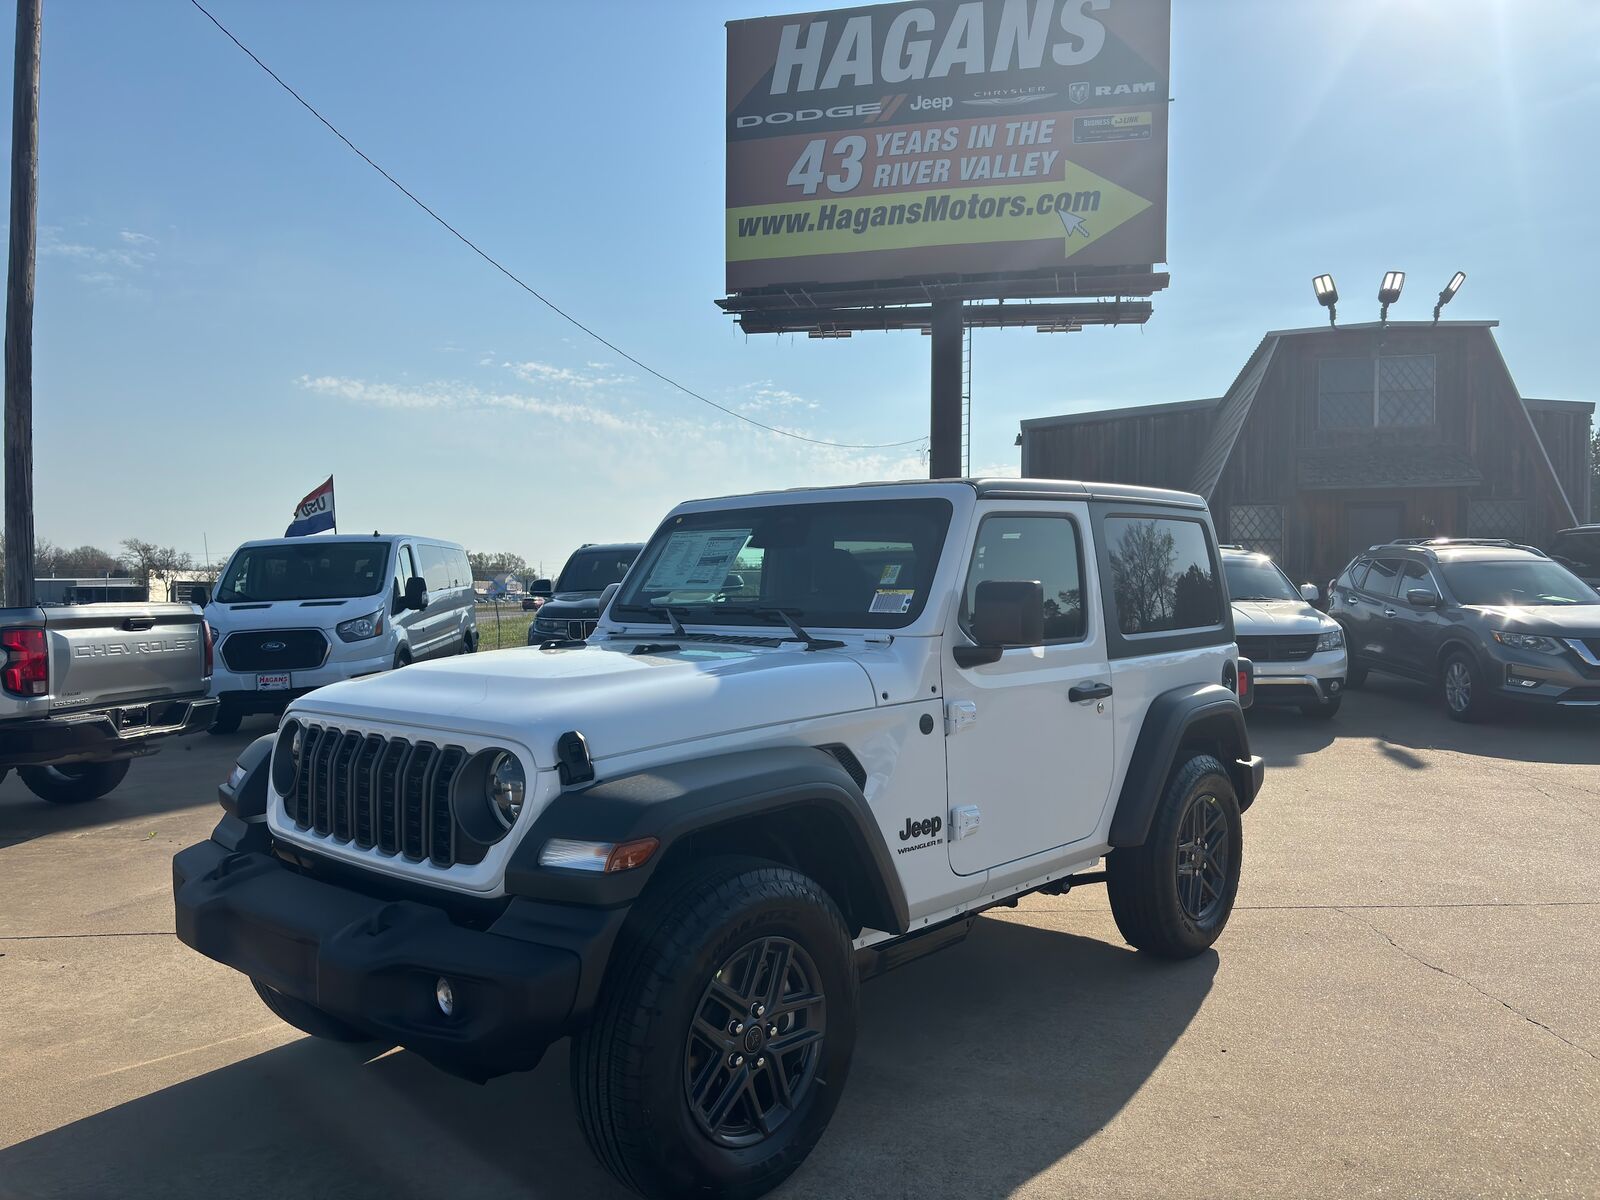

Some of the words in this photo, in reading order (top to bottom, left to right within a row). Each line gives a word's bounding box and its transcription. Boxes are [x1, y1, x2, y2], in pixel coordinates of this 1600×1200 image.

[770, 0, 1111, 95] HAGANS
[974, 86, 1046, 97] CHRYSLER
[1095, 82, 1155, 96] RAM
[736, 102, 882, 128] DODGE
[910, 95, 953, 111] Jeep
[874, 127, 960, 157] YEARS
[967, 124, 997, 149] IN
[1005, 119, 1056, 147] THE
[786, 135, 867, 195] 43
[872, 158, 951, 188] RIVER
[960, 150, 1060, 181] VALLEY
[737, 190, 1101, 237] www.HagansMotors.com
[73, 638, 197, 659] CHEVROLET
[259, 676, 288, 684] HAGANS
[899, 816, 942, 841] Jeep
[897, 840, 936, 855] WRANGLER
